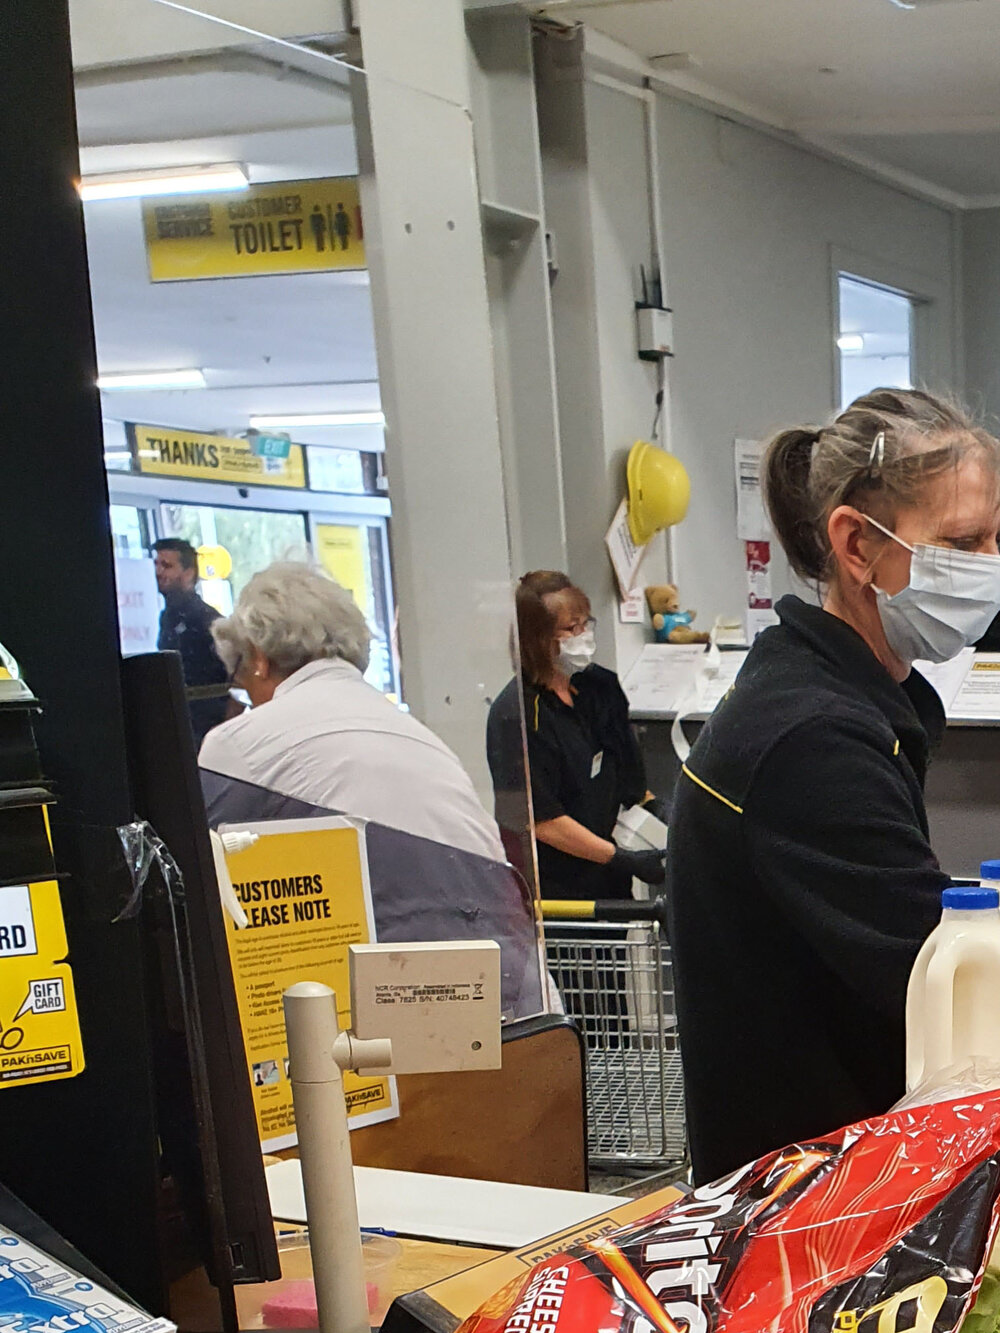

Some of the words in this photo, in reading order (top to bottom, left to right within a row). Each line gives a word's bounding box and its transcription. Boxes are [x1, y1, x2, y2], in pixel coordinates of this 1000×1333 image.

[229, 219, 303, 255] TOILET
[146, 438, 219, 468] THANKS
[234, 904, 289, 930] LEASE
[293, 899, 331, 922] NOTE
[0, 924, 27, 950] RD
[34, 982, 60, 998] GIFT
[35, 996, 61, 1010] CARD
